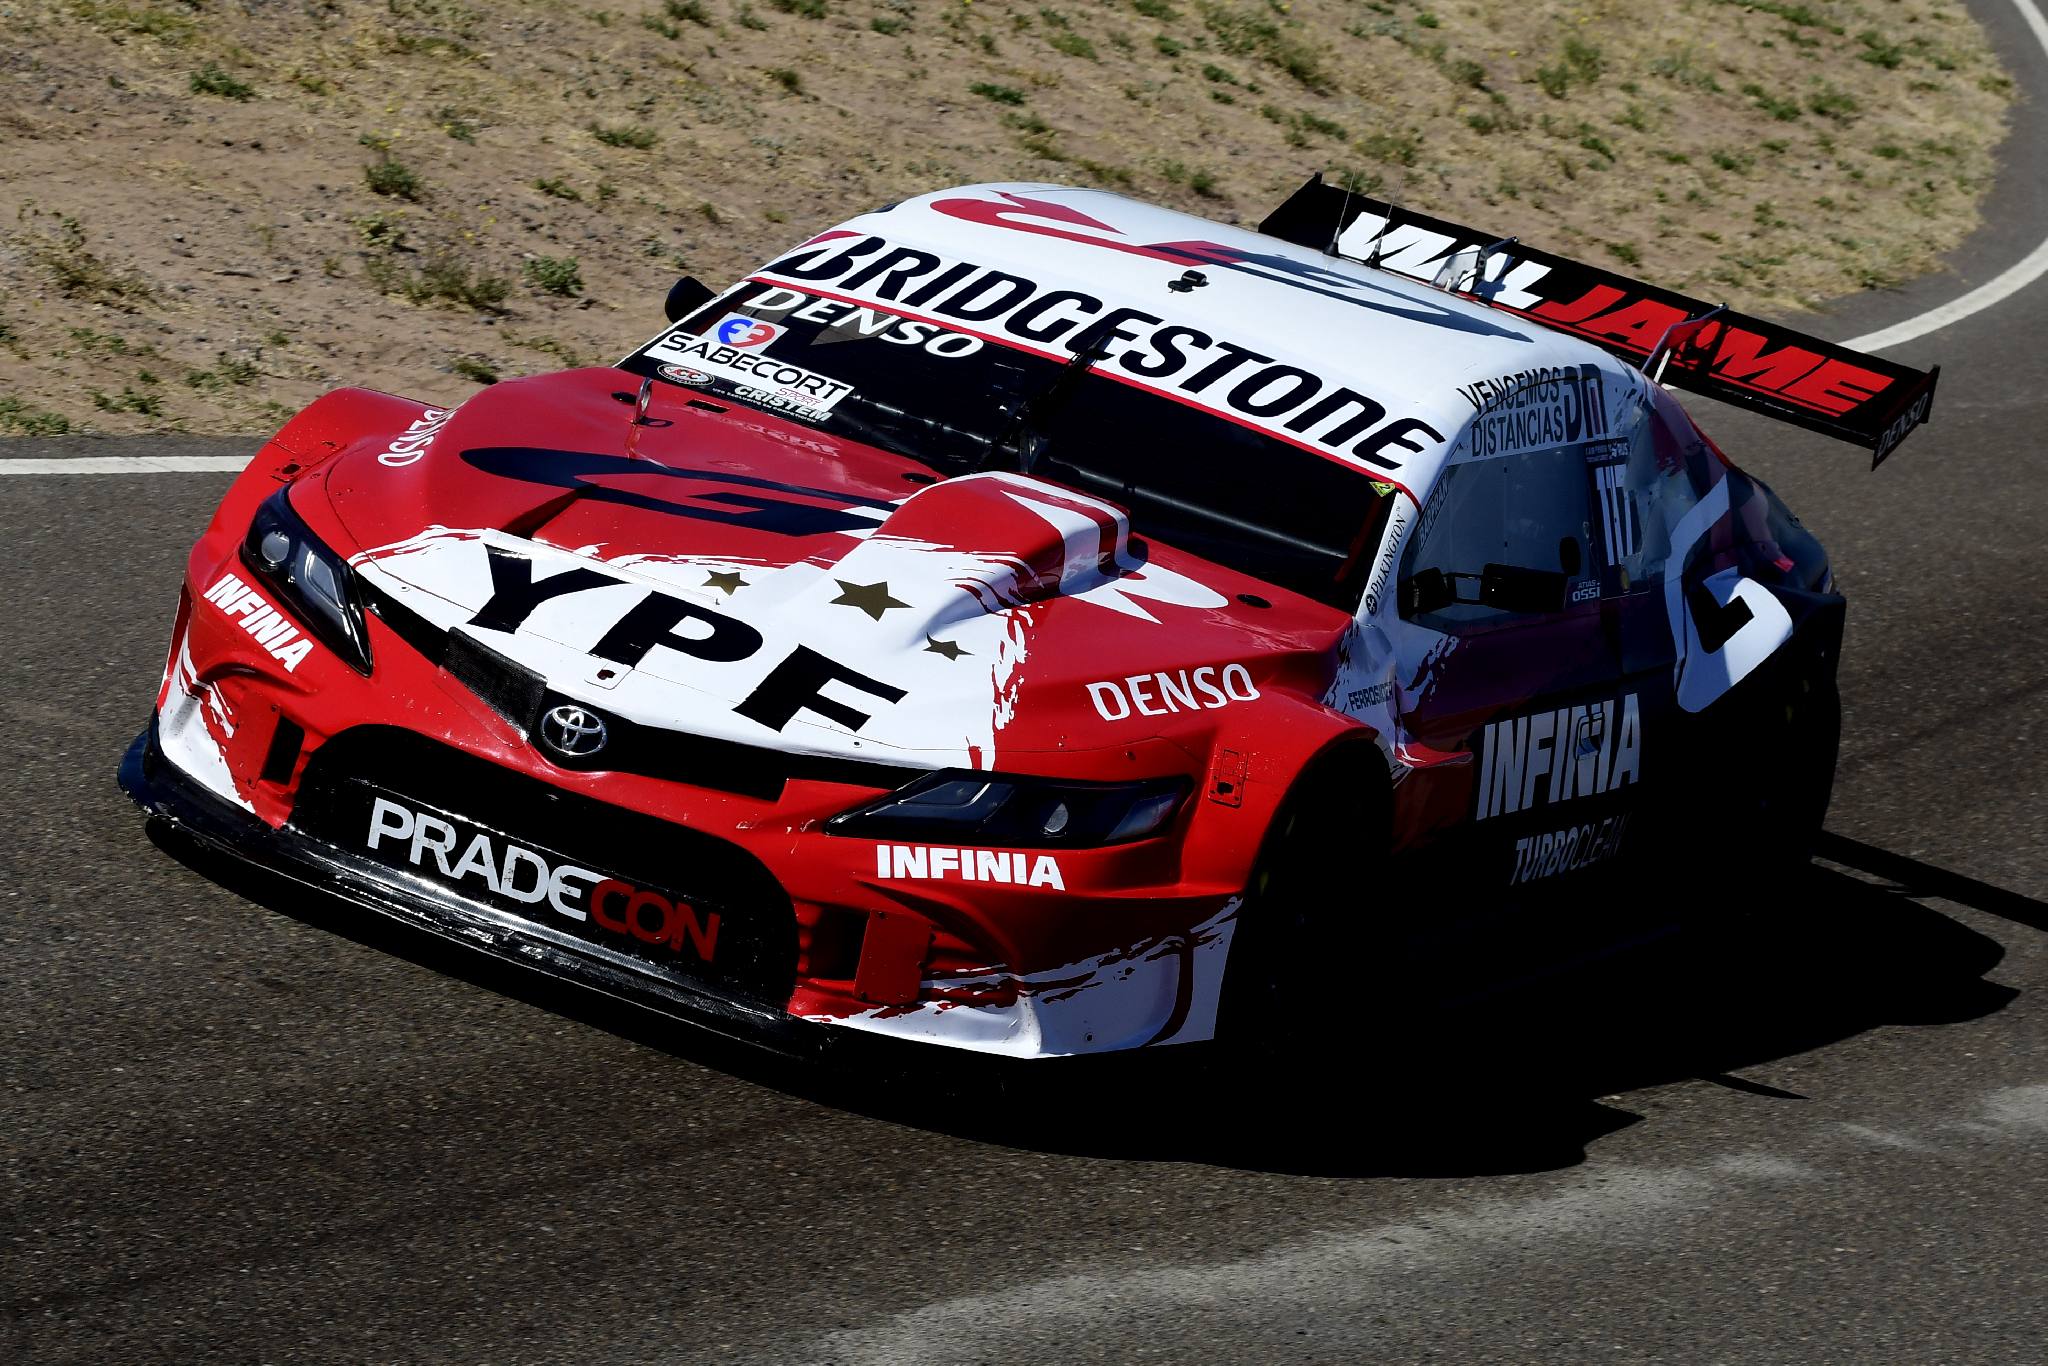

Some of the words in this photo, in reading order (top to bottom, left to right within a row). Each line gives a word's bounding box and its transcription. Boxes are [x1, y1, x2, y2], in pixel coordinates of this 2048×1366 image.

[743, 288, 984, 358] DENSO
[775, 236, 1446, 470] BRIDGESTONE
[661, 333, 849, 399] SABECORT
[1456, 366, 1560, 415] VENCEMOS
[734, 386, 833, 421] CRISTEM
[1471, 406, 1563, 457] DISTANCIAS
[1371, 515, 1406, 600] PILKINGTON
[203, 573, 315, 672] INFINIA
[466, 543, 909, 733] YPF
[1086, 663, 1261, 722] DENSO
[1476, 692, 1641, 822] INFINIA
[367, 797, 721, 962] PRADECON
[876, 844, 1067, 891] INFINIA
